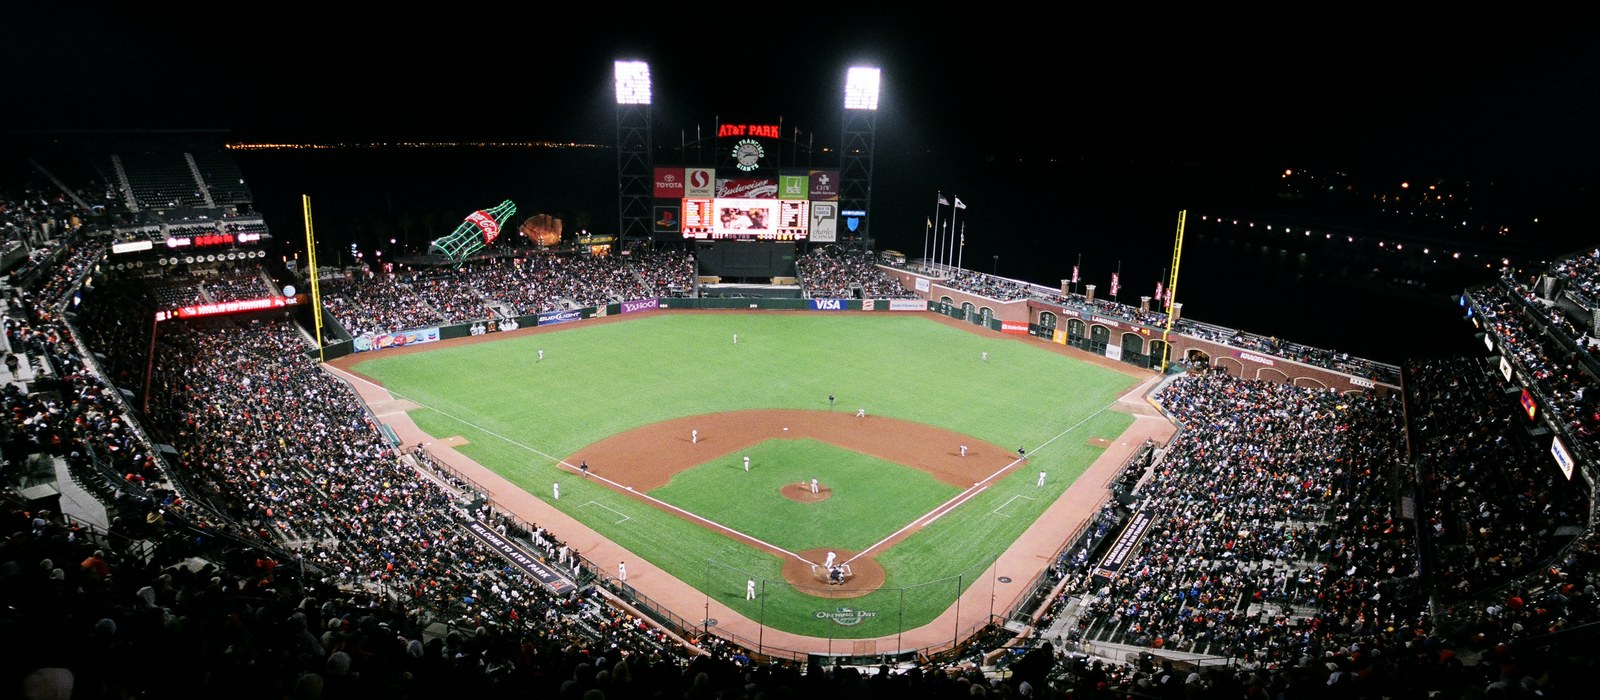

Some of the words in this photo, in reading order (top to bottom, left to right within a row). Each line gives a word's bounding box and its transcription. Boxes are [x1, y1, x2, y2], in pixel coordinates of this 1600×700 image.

[718, 124, 746, 138] AT&T
[748, 124, 779, 139] PARK
[739, 139, 765, 158] FRANCISCO
[736, 162, 759, 172] GIANTS
[717, 180, 769, 199] Budweiser
[816, 300, 840, 310] VISA
[1092, 316, 1119, 327] LANDING
[471, 523, 502, 545] WELCOME
[501, 543, 513, 553] TO
[510, 551, 531, 565] AT&T
[527, 563, 551, 578] PARK
